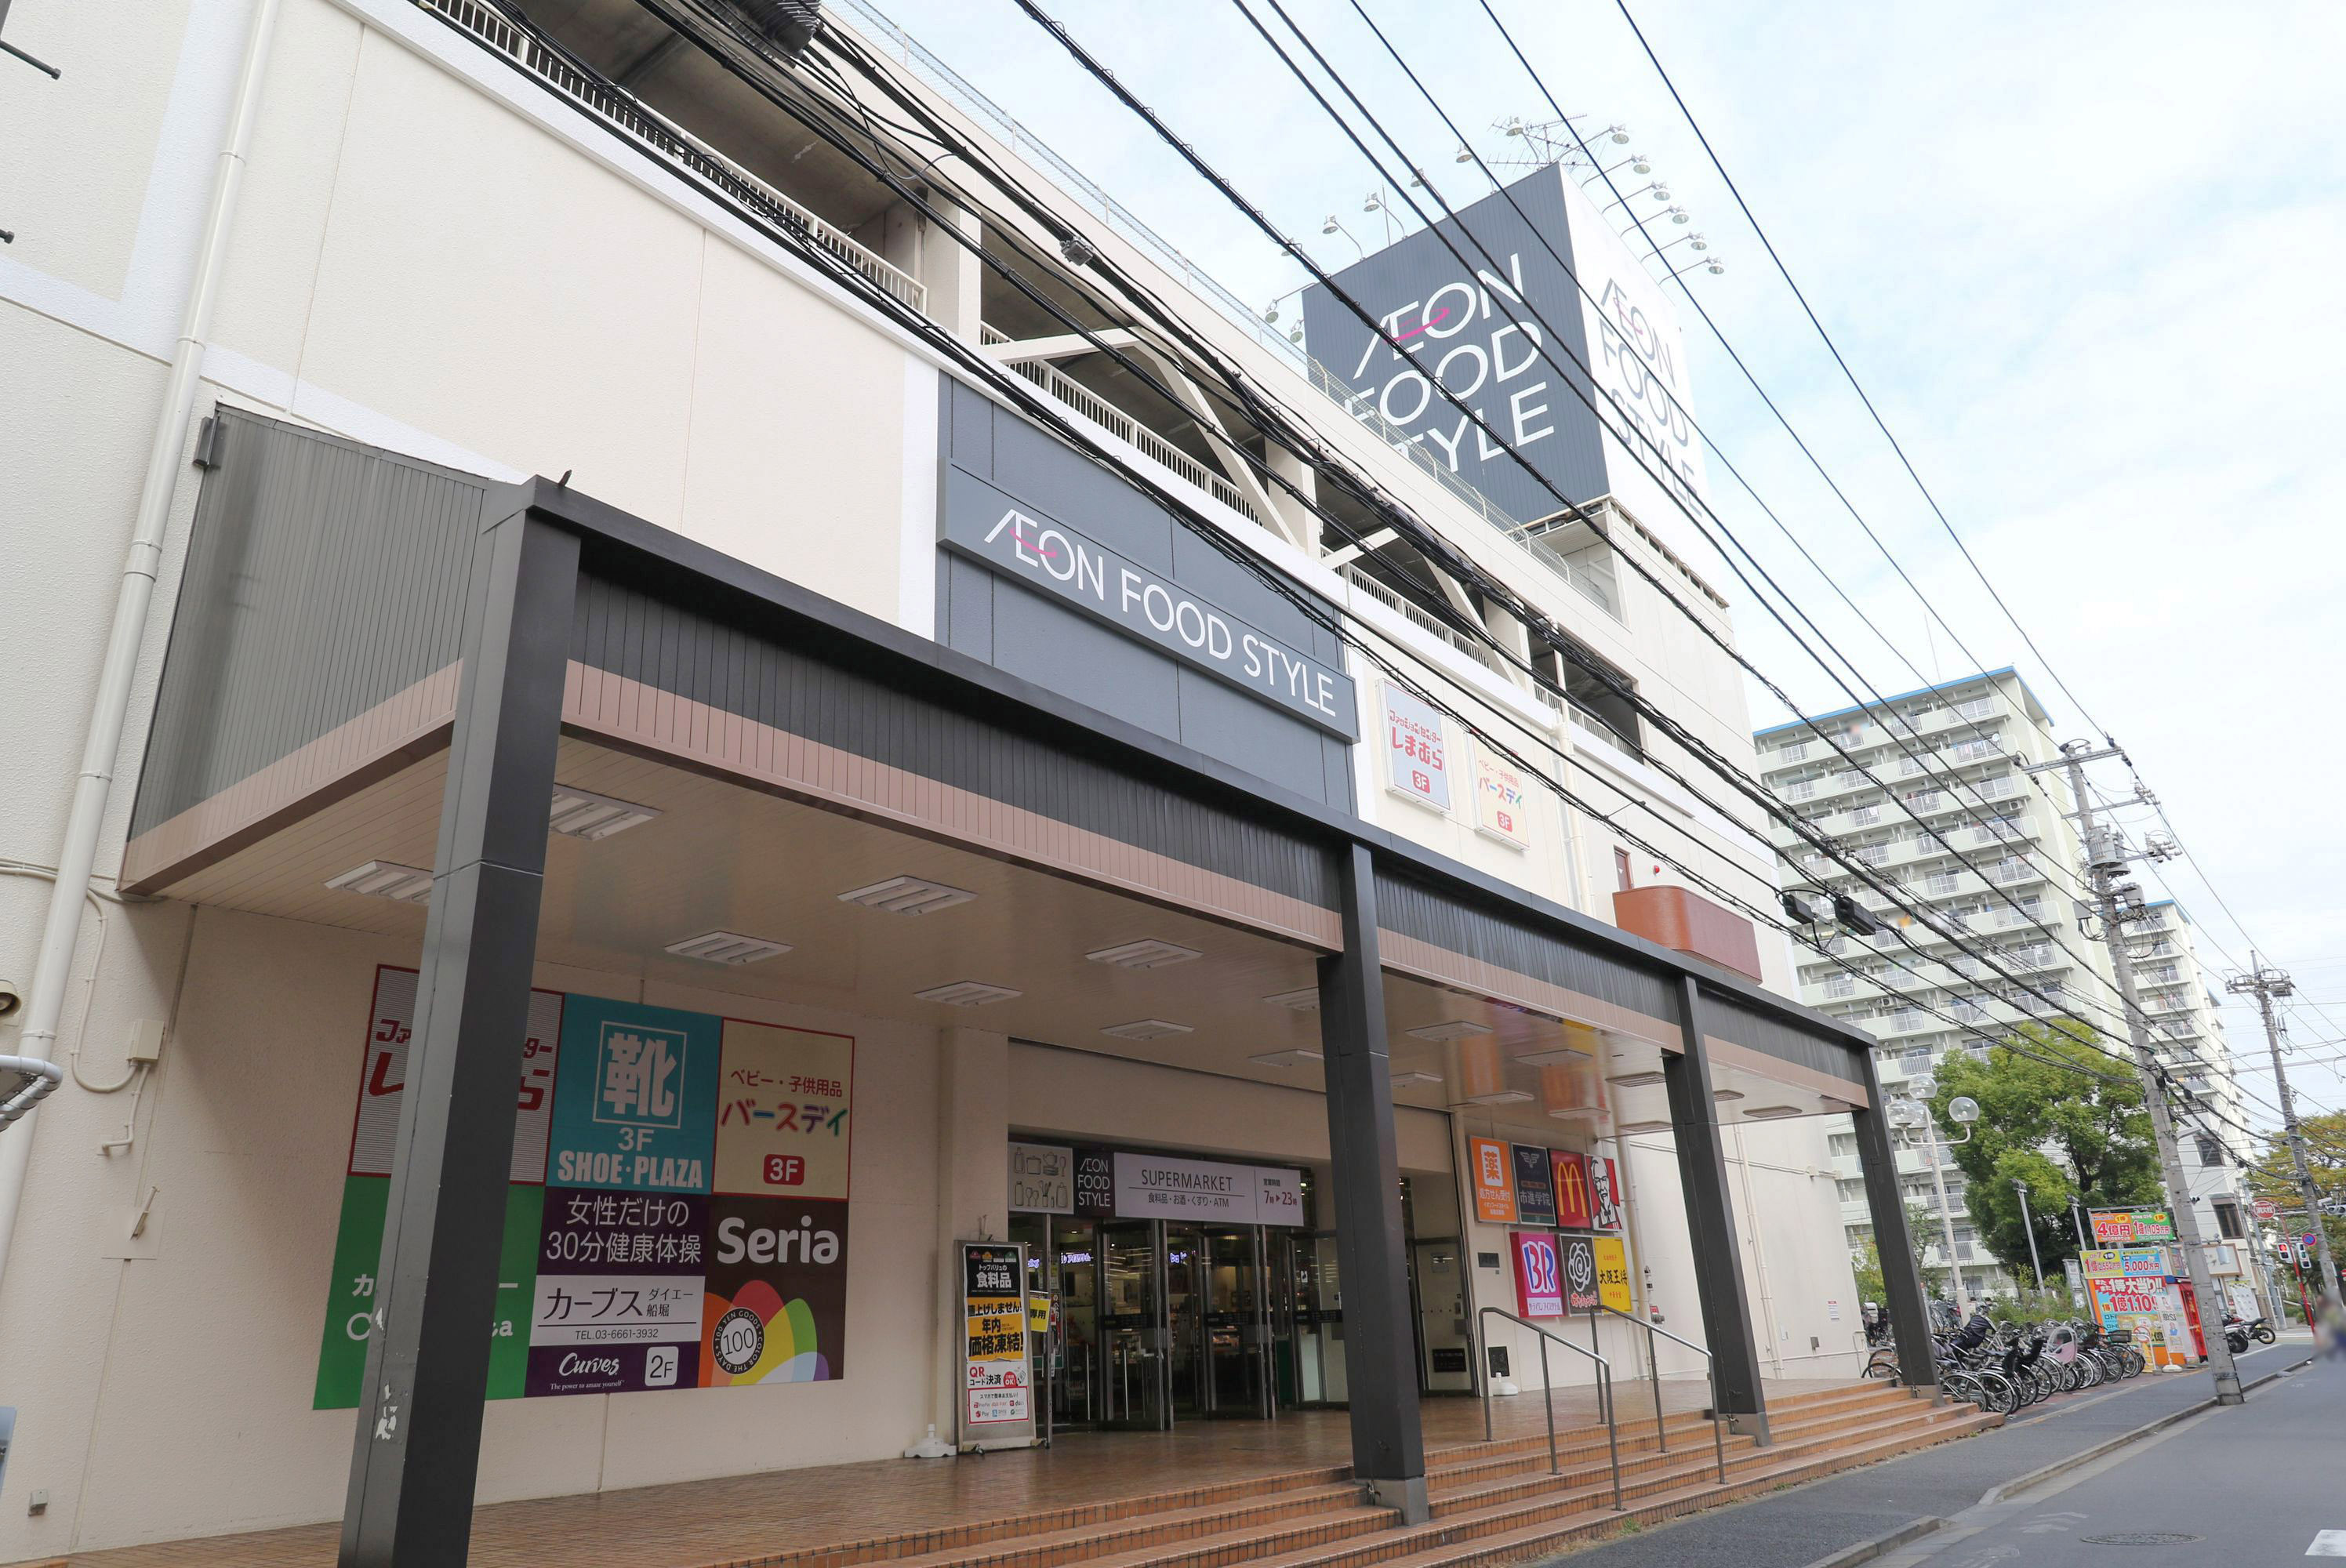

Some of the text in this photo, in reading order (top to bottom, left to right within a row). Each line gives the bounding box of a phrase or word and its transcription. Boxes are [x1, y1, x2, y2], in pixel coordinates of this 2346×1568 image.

[1599, 316, 1689, 447] FOOD
[1611, 388, 1703, 518] STYLE
[1121, 568, 1233, 660] FOOD
[1243, 634, 1336, 717] STYLE
[1392, 726, 1443, 771] しまむら
[1414, 771, 1427, 791] 3F
[1498, 812, 1511, 829] 3F
[603, 1033, 677, 1117] 靴
[731, 1069, 842, 1098] ベビー・子供用品
[618, 1127, 654, 1151] 3F
[770, 1158, 799, 1181] 3F
[1142, 1169, 1233, 1192] SUPERMARKET
[1078, 1174, 1110, 1189] FOOD
[566, 1194, 689, 1227] 女性だけの
[1078, 1192, 1110, 1207] STYLE
[717, 1215, 839, 1264] Seria
[2097, 1222, 2131, 1236] 4億円
[547, 1232, 701, 1264] 30分健康体操
[976, 1272, 1011, 1288] 食料品
[1600, 1269, 1628, 1287] 大阪王将
[543, 1287, 643, 1319] カーブス
[648, 1288, 694, 1301] ダイエー
[646, 1304, 670, 1317] 船堀
[723, 1312, 736, 1324] YEN
[739, 1310, 760, 1330] GOODS
[576, 1329, 659, 1341] TEL.03-6661-3932
[982, 1318, 1001, 1334] 年内
[723, 1328, 754, 1356] 100
[558, 1352, 619, 1376] Curves
[649, 1355, 674, 1378] 2F
[715, 1337, 763, 1373] COLOR THE DAYS
[969, 1367, 985, 1377] QR
[969, 1374, 1001, 1385] コード決済
